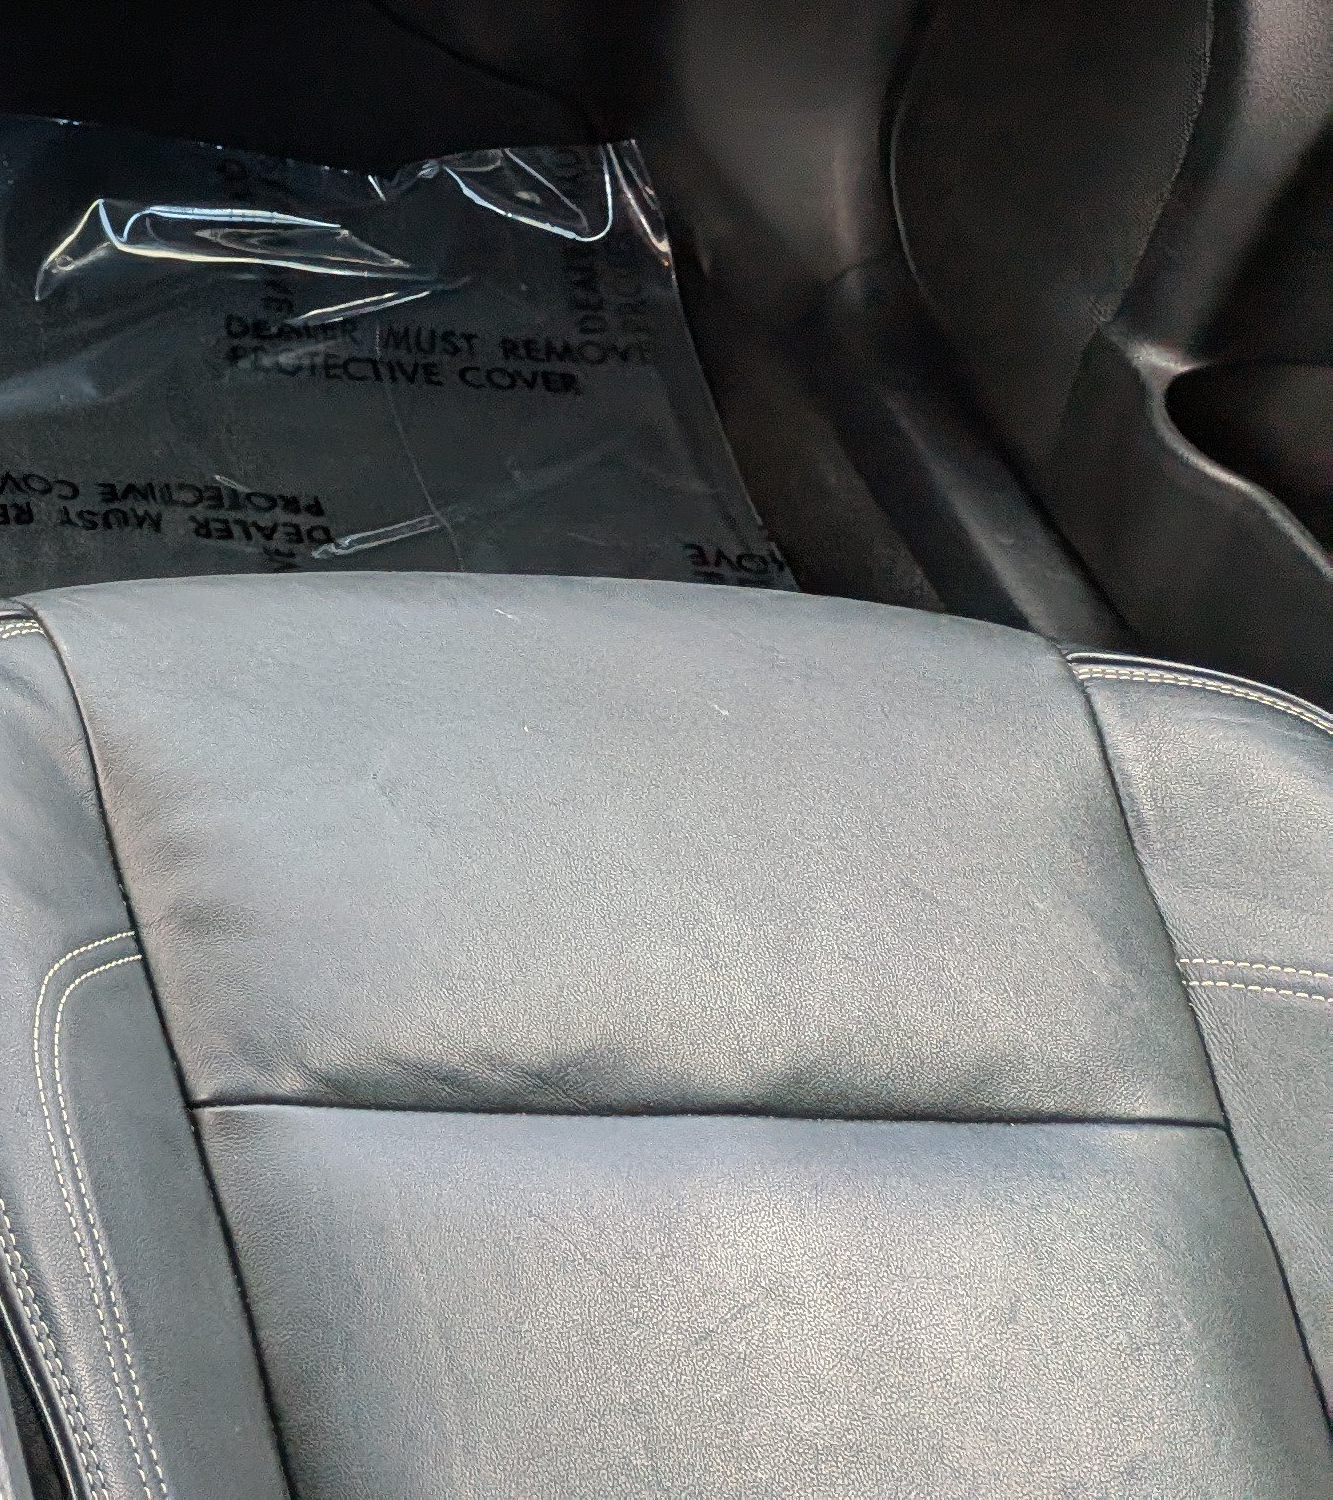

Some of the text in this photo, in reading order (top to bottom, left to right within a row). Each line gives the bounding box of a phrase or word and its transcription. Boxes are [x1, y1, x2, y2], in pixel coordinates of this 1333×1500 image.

[379, 325, 477, 358] MUST
[458, 366, 584, 397] COVER
[96, 481, 325, 518] PROTECTIVE
[60, 503, 163, 533] MUST
[193, 514, 334, 547] DEALER
